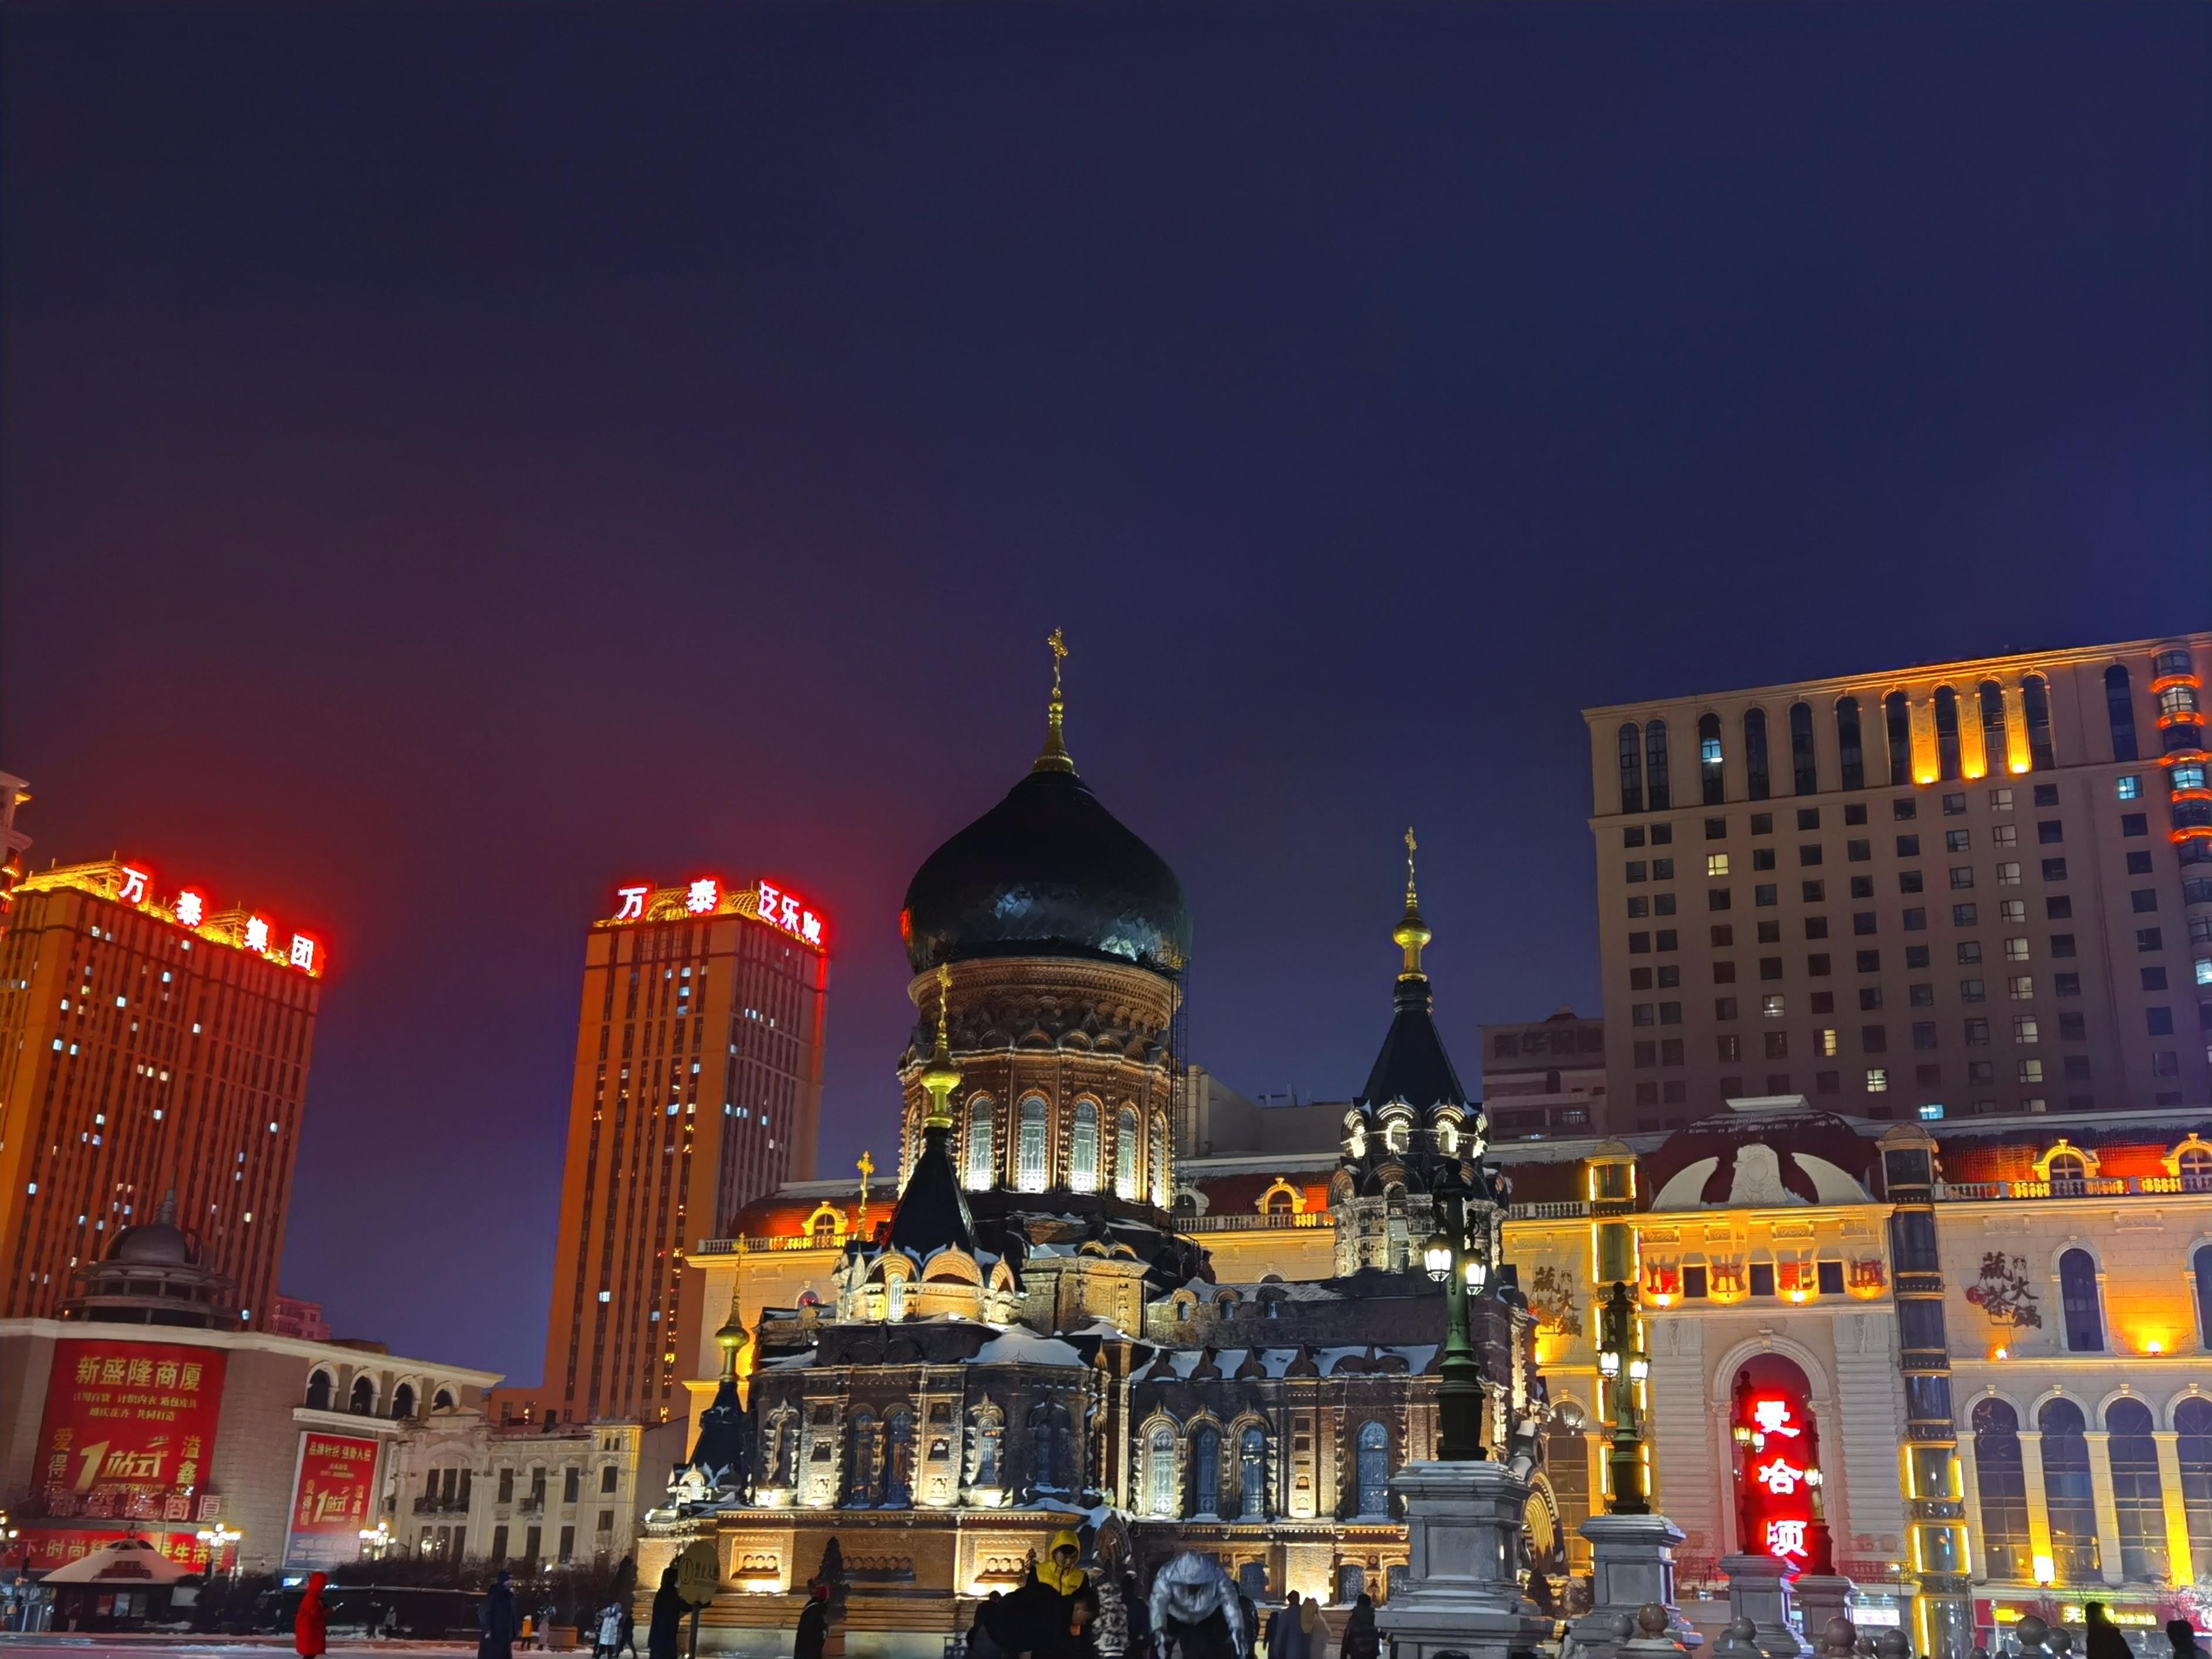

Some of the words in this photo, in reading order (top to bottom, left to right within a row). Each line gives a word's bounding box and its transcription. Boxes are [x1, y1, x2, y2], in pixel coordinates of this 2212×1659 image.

[118, 866, 315, 971] 万泰集团
[616, 879, 717, 920] 万泰
[75, 1355, 203, 1391] 新盛隆商厦
